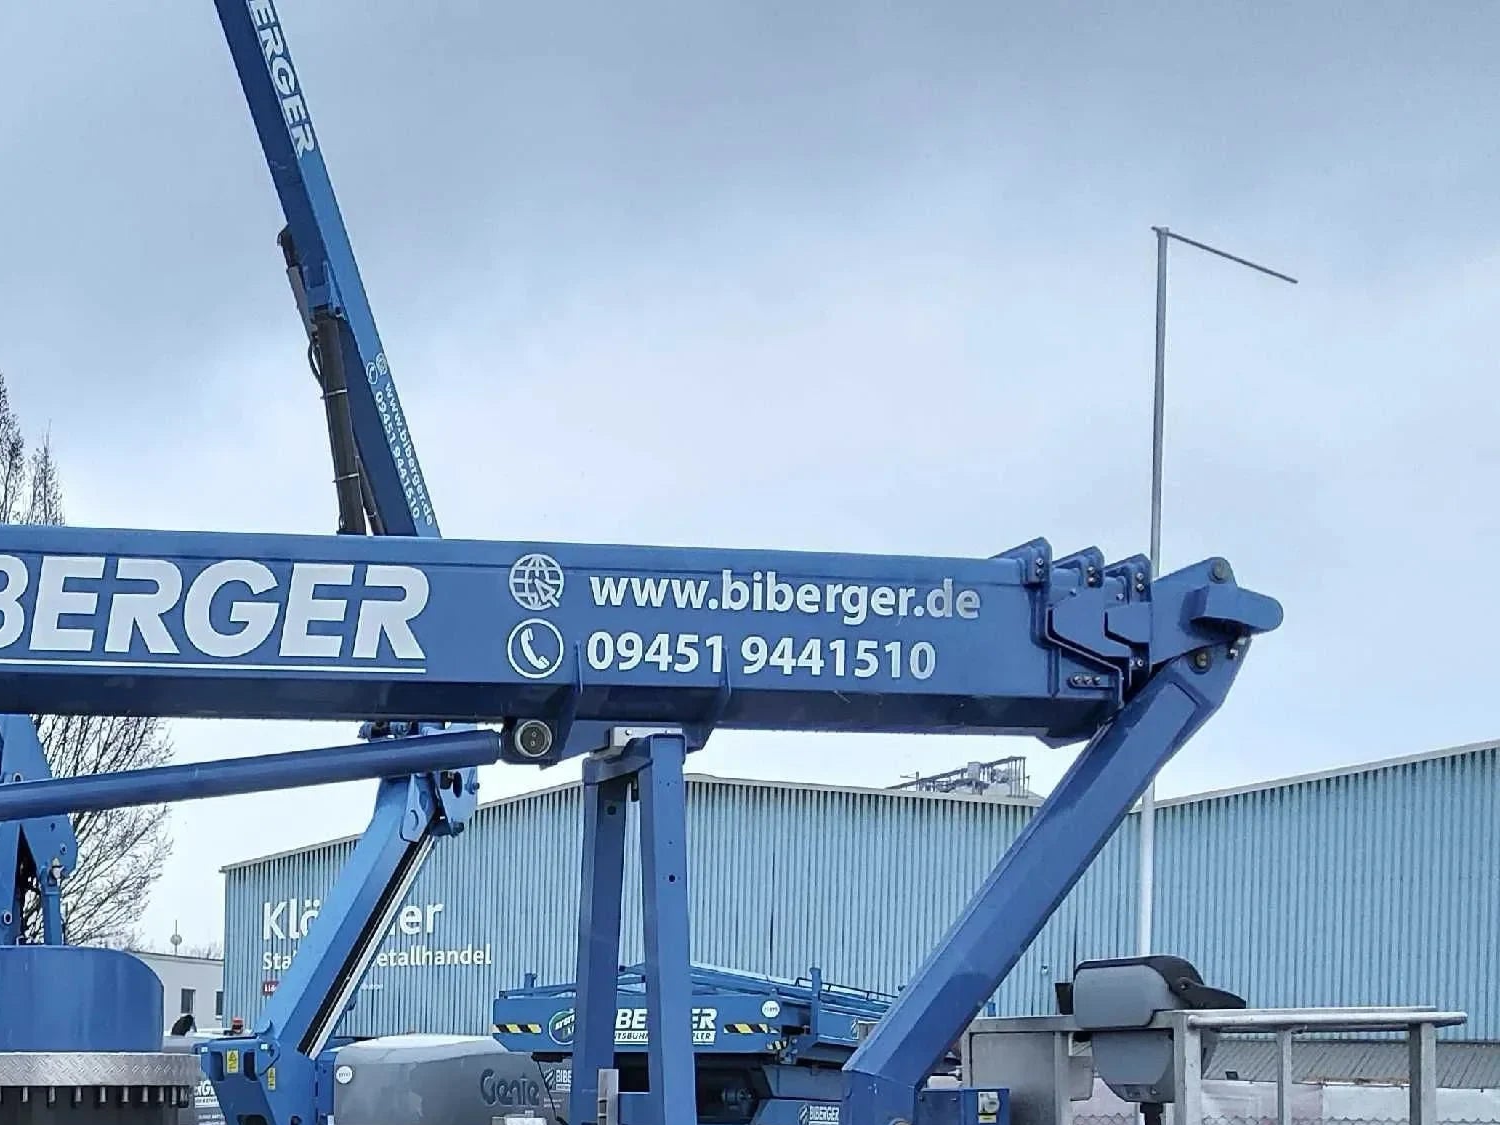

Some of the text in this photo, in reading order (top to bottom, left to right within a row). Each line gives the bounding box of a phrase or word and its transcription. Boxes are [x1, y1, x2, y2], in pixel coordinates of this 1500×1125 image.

[375, 391, 397, 444] 09451
[385, 382, 433, 526] www.biberger.de
[394, 446, 420, 519] 9441510
[589, 569, 981, 625] www.biberger.de
[587, 631, 937, 680] 09451 9441510
[372, 943, 493, 968] etallhandel
[480, 1068, 540, 1107] Genie
